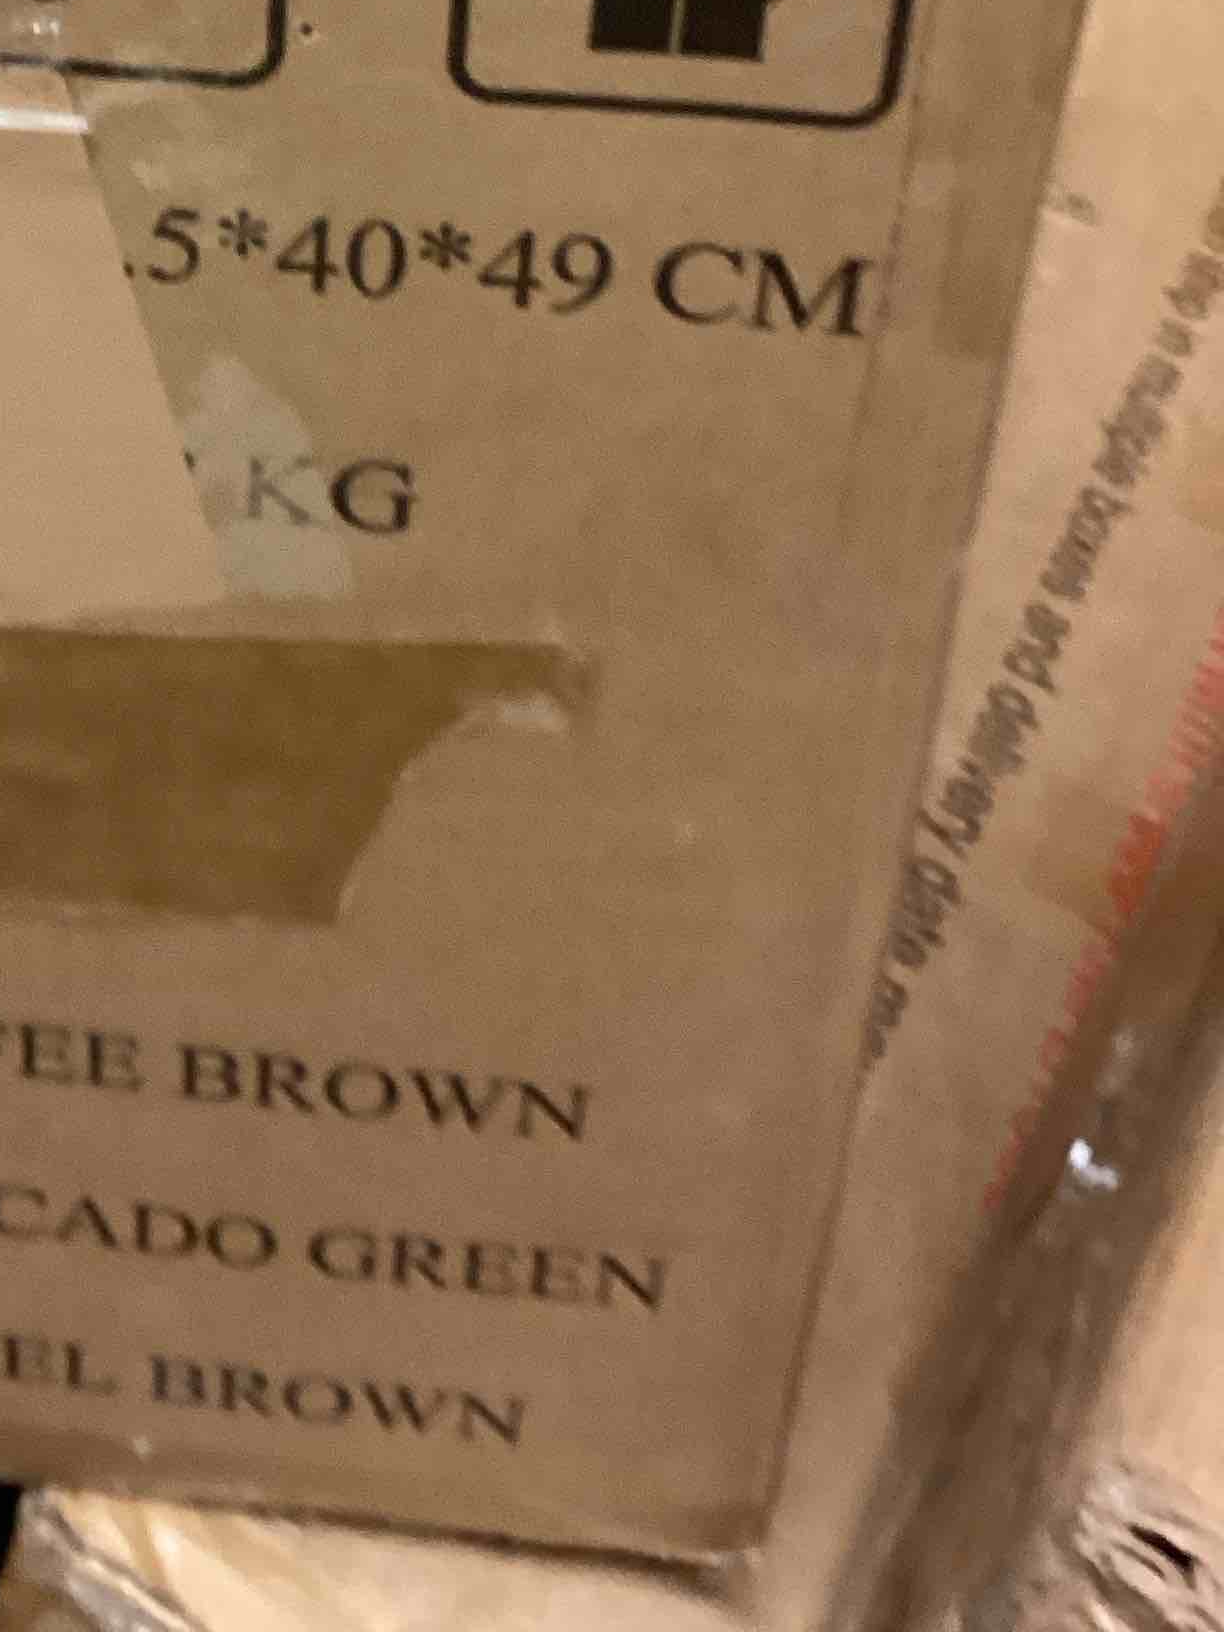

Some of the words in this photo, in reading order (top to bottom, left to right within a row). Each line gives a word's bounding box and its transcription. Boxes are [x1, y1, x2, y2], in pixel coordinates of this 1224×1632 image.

[652, 240, 874, 338] CM
[244, 453, 419, 535] KG
[1038, 483, 1135, 601] boxes
[1001, 602, 1073, 695] and
[917, 681, 1041, 862] delivery
[888, 855, 966, 970] date
[177, 1042, 591, 1143] BROWN
[306, 1226, 669, 1313] GREEN
[149, 1352, 527, 1448] BROWN
